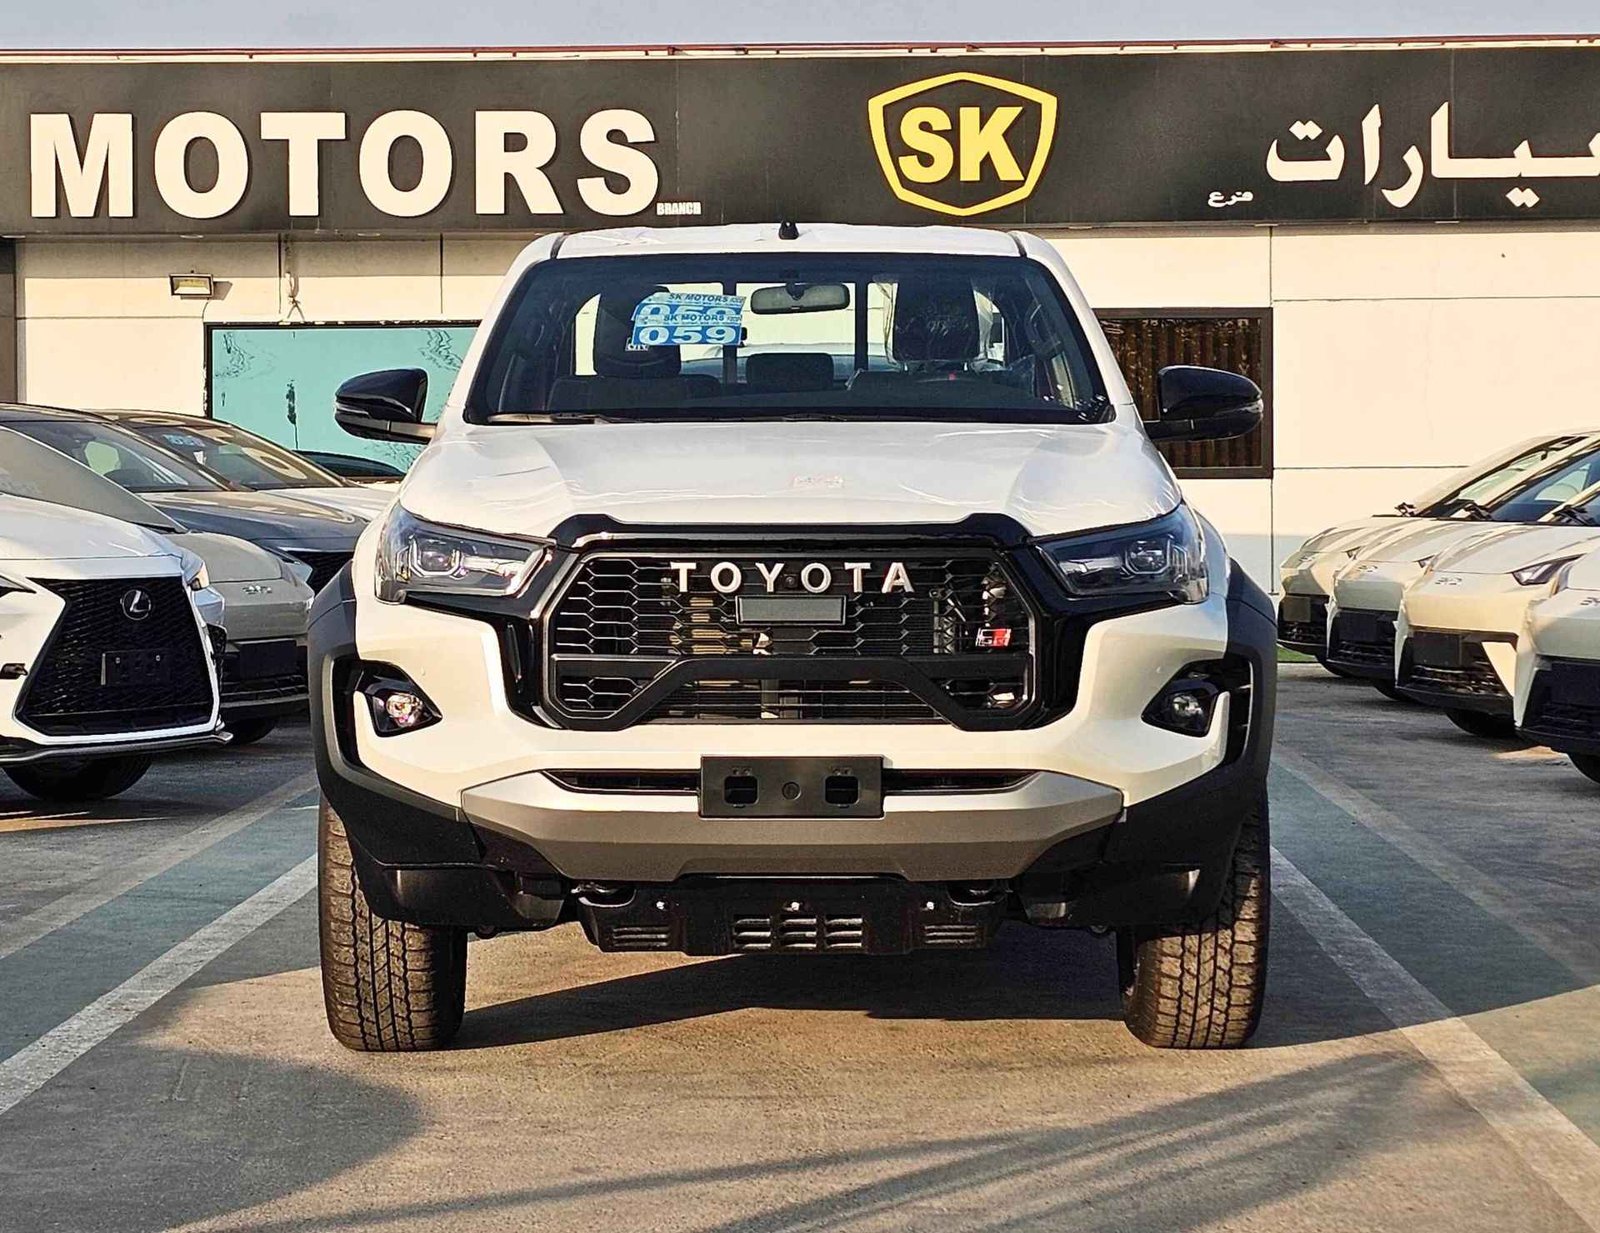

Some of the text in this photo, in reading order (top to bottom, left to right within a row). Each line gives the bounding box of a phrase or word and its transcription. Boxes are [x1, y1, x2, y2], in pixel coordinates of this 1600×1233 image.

[898, 106, 1025, 184] SK
[29, 109, 659, 218] MOTORS
[1265, 101, 1600, 208] يارات
[1207, 191, 1254, 208] فرع
[656, 202, 702, 216] BRANCH
[685, 294, 729, 303] MOTORS
[664, 314, 678, 322] SK
[681, 314, 725, 322] MOTORS
[639, 326, 736, 344] 059
[669, 562, 915, 594] TOYOTA
